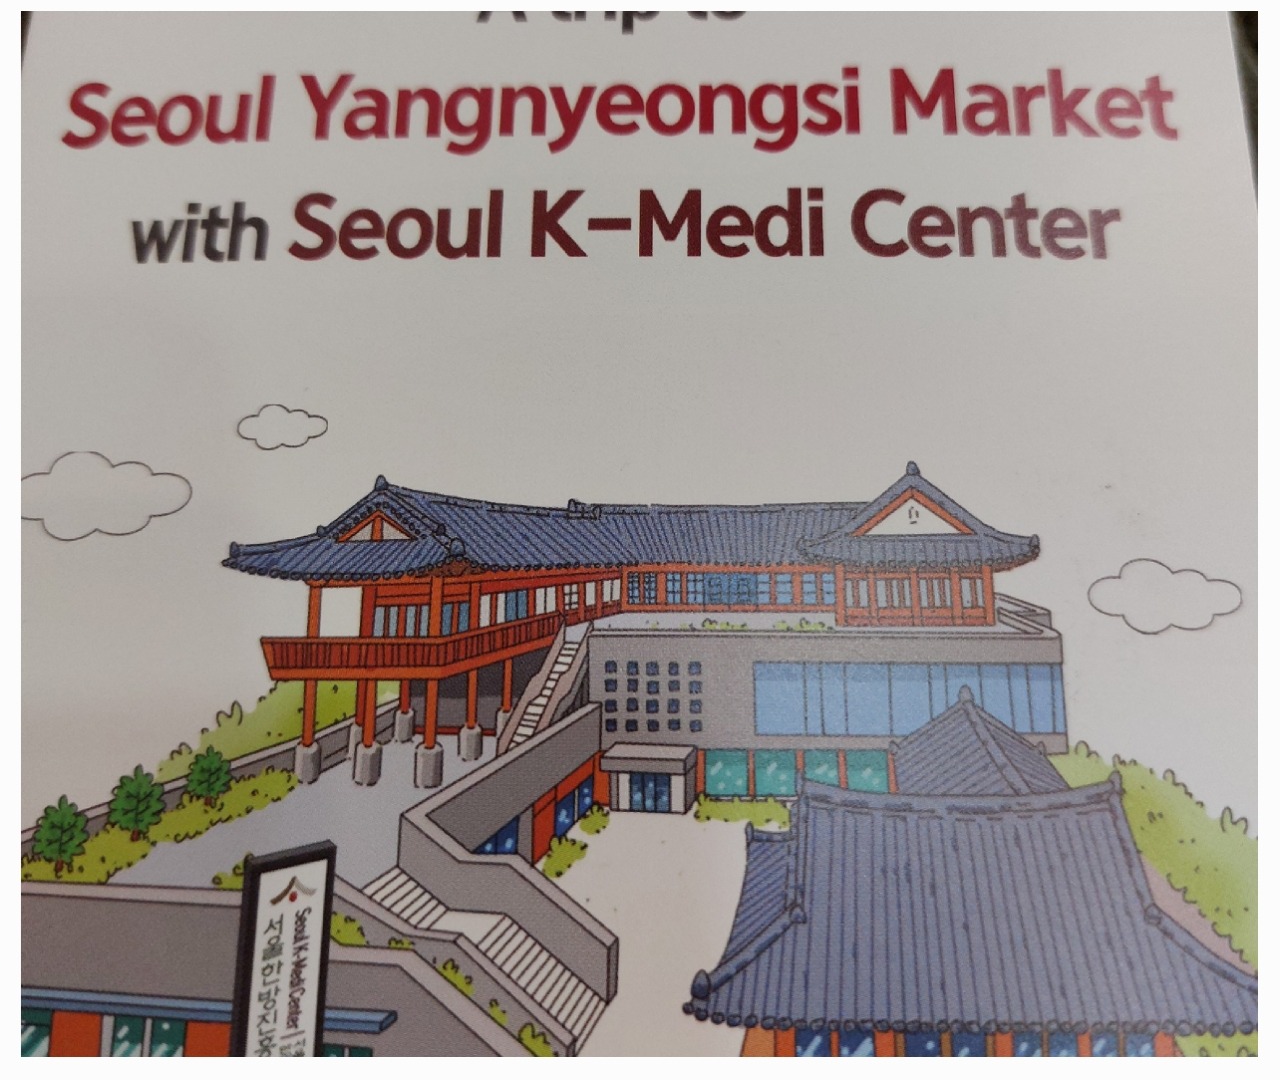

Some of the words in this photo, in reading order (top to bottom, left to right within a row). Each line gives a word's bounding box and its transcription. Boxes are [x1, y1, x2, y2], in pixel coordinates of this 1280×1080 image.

[61, 76, 276, 151] Seoul
[300, 69, 860, 155] Yangnyeongsi
[891, 67, 1179, 142] Market
[130, 202, 267, 264] with
[288, 190, 503, 262] Seoul
[532, 187, 825, 260] K-Medi
[852, 190, 1121, 260] Center
